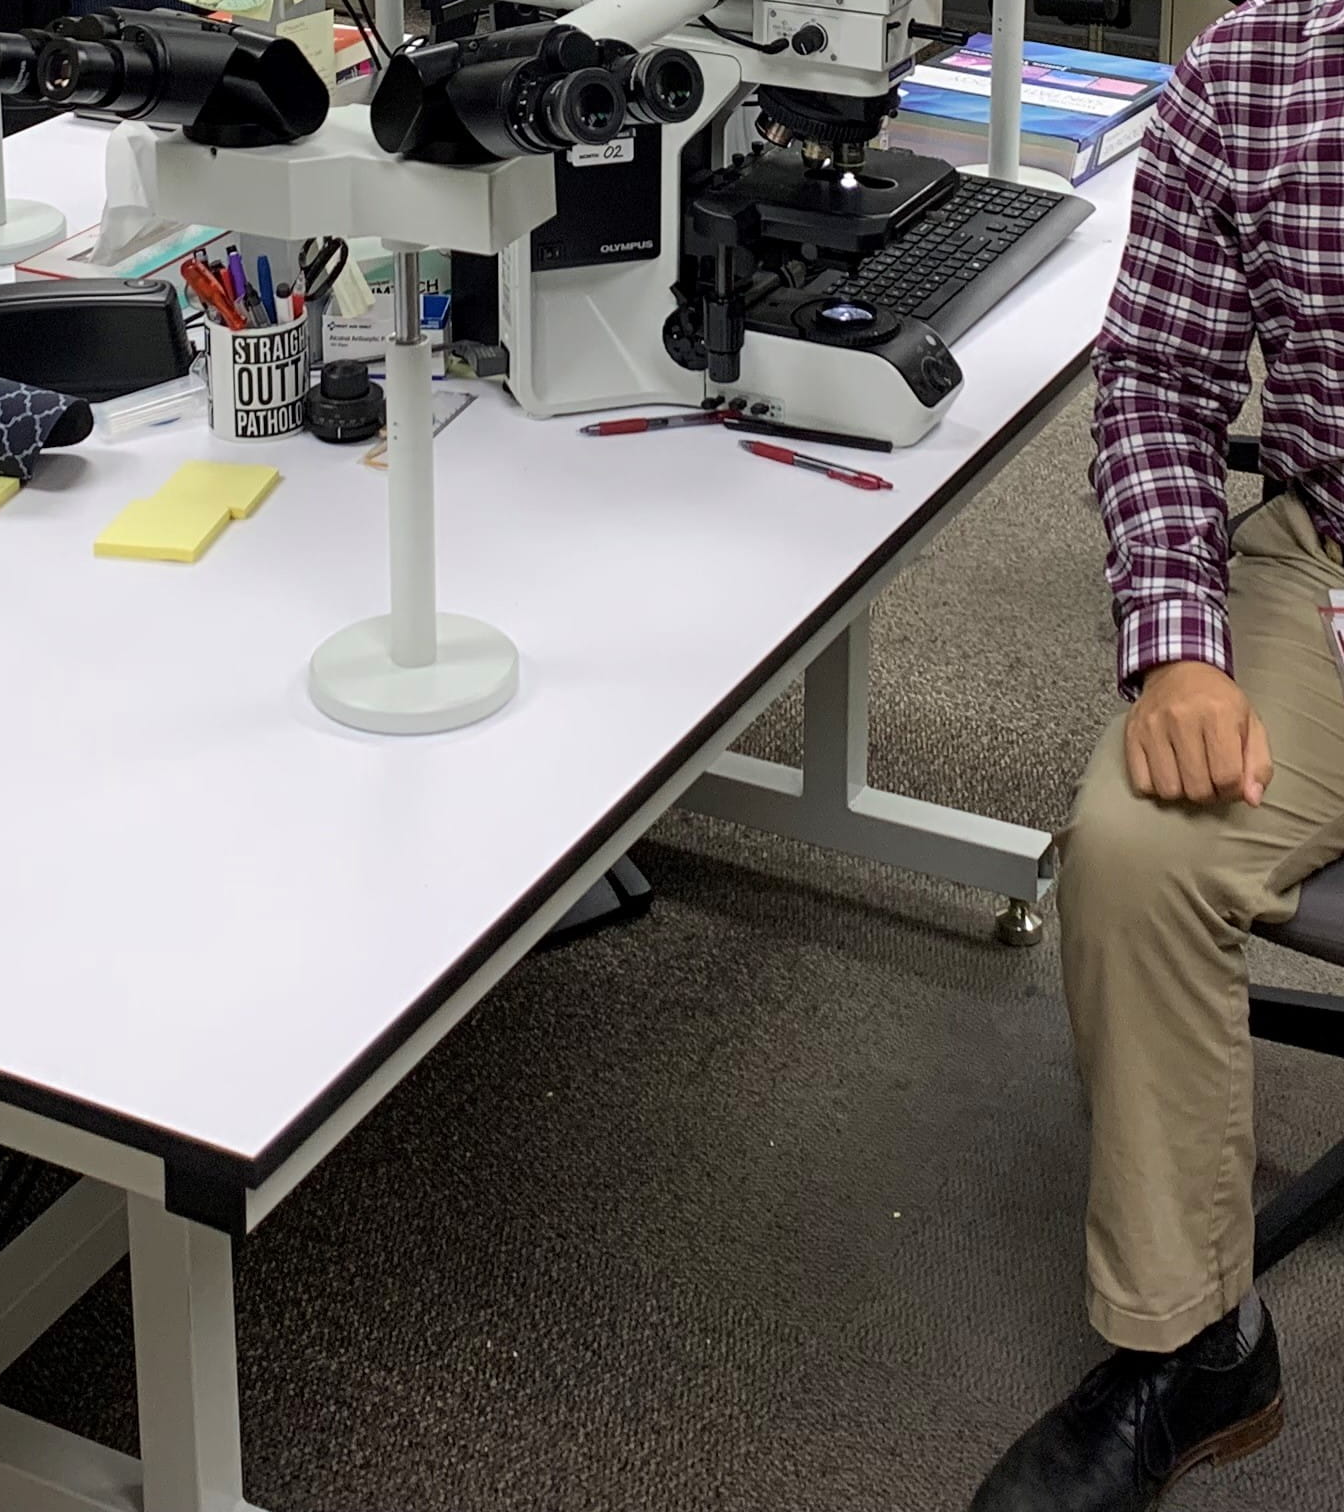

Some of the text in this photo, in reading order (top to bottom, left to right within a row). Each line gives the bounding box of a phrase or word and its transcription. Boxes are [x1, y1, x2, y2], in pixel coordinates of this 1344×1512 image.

[603, 145, 623, 159] 02
[600, 240, 654, 254] OLYMPUS
[234, 326, 304, 364] STRAIGH
[237, 356, 305, 407] OUTT
[237, 400, 303, 437] PATHOLO
